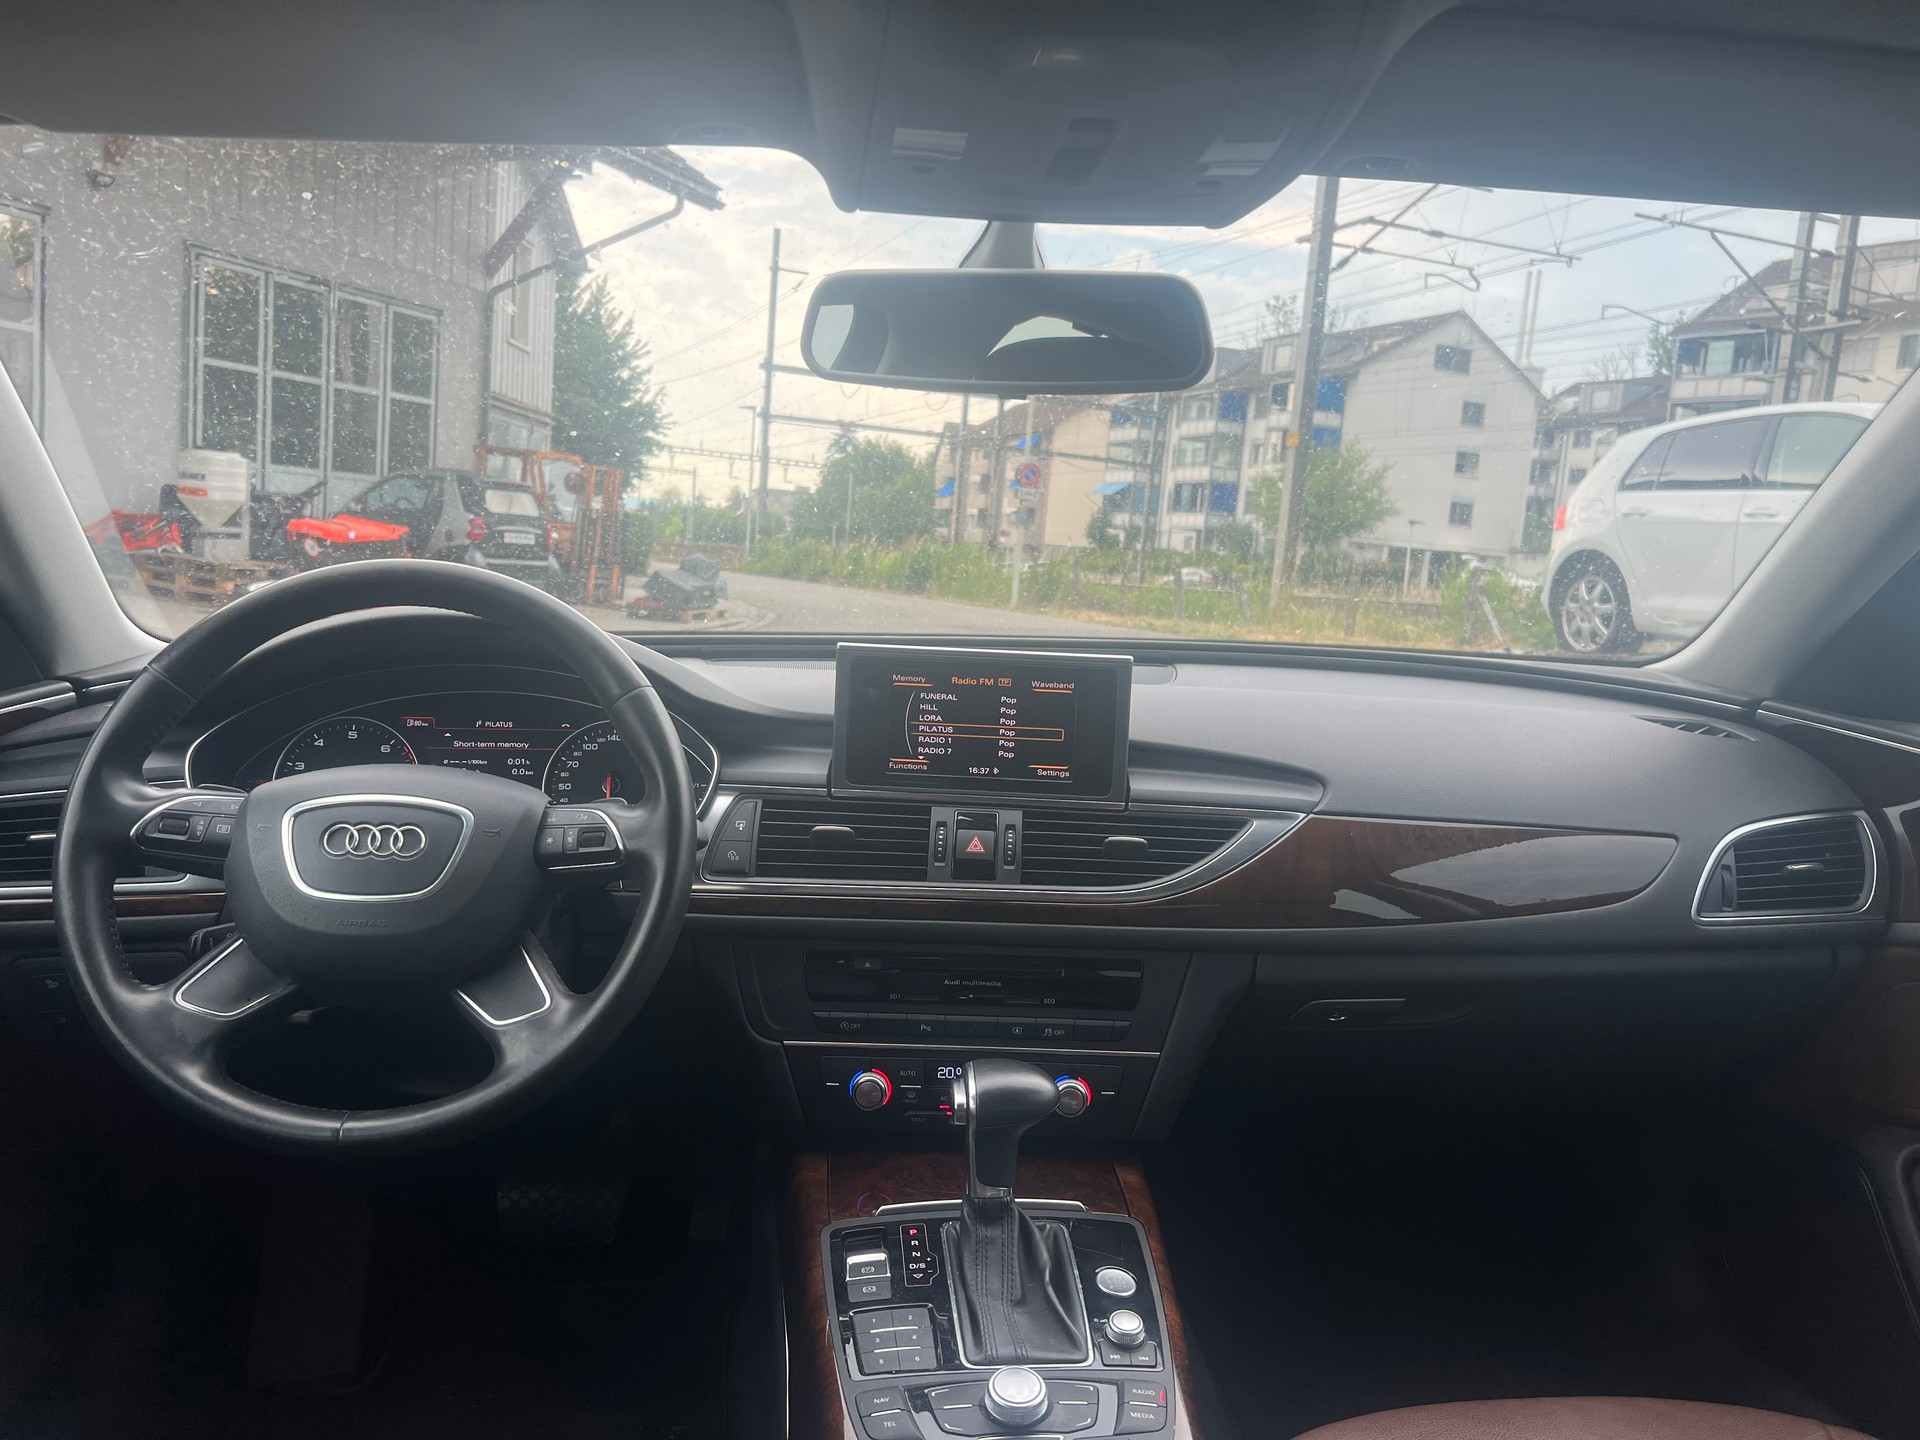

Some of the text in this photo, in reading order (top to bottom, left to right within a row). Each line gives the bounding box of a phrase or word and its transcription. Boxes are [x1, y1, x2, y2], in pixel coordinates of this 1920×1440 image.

[892, 674, 926, 683] Memory
[951, 676, 977, 685] Radio
[979, 678, 994, 686] FM
[1031, 680, 1075, 689] Waveband
[920, 692, 1017, 704] FUNERAL Pop
[919, 703, 1017, 715] HILL Pop
[919, 714, 1016, 726] LORA Pop
[348, 731, 358, 739] 5
[918, 725, 1015, 737] PILATUS Pop
[453, 740, 496, 748] Short-term
[918, 736, 945, 744] RADIO
[999, 740, 1015, 748] Pop
[998, 750, 1015, 758] Pop
[295, 762, 305, 770] 3
[889, 762, 928, 770] Functions
[1037, 769, 1070, 778] Settings
[336, 920, 389, 928] AIRBAG
